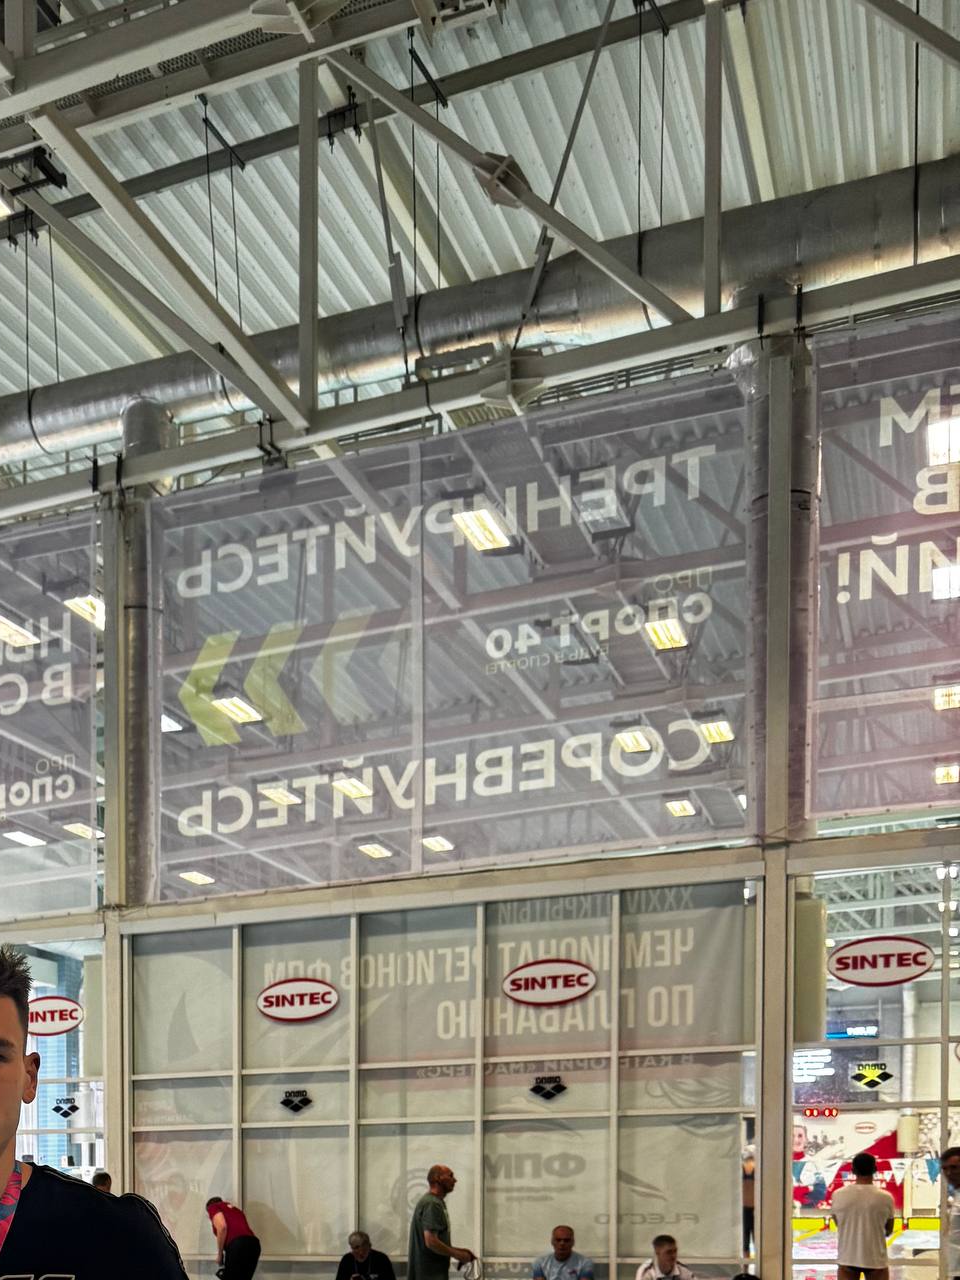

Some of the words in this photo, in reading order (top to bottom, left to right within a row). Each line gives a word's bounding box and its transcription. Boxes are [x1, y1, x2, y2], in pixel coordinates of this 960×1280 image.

[836, 952, 926, 971] SINTEC
[509, 972, 589, 991] SINTEC
[263, 991, 332, 1008] SINTEC
[29, 1008, 78, 1023] INTEC
